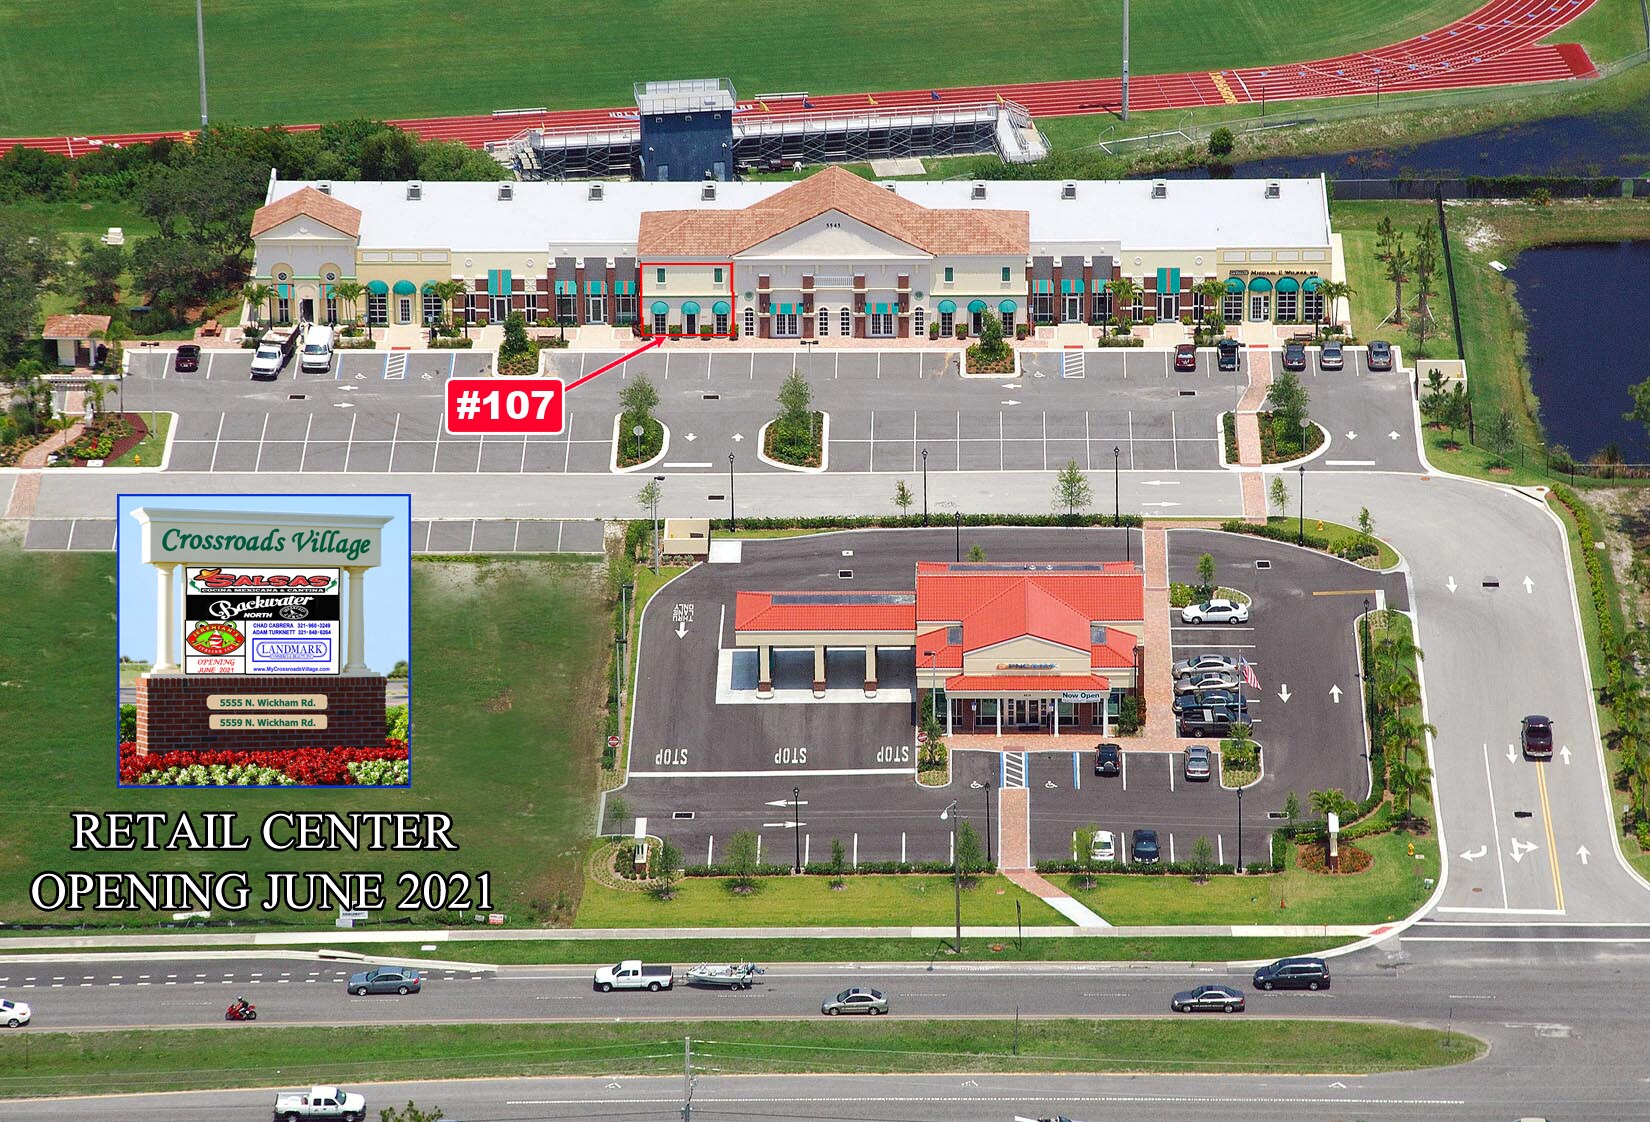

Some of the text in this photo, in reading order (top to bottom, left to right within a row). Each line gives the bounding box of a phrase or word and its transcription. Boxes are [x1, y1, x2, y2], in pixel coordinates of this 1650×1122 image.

[162, 528, 371, 561] Crossroads Village
[205, 573, 331, 587] SALSAS
[208, 595, 315, 620] Backwater
[261, 644, 323, 654] LANDMARK
[197, 658, 236, 666] OPENING
[219, 699, 316, 707] 5555 N. Wickham Rd.
[219, 718, 316, 727] 5559 N. Wickham Rd.
[655, 748, 688, 765] STOP
[774, 747, 807, 764] STOP
[876, 746, 909, 763] STOP
